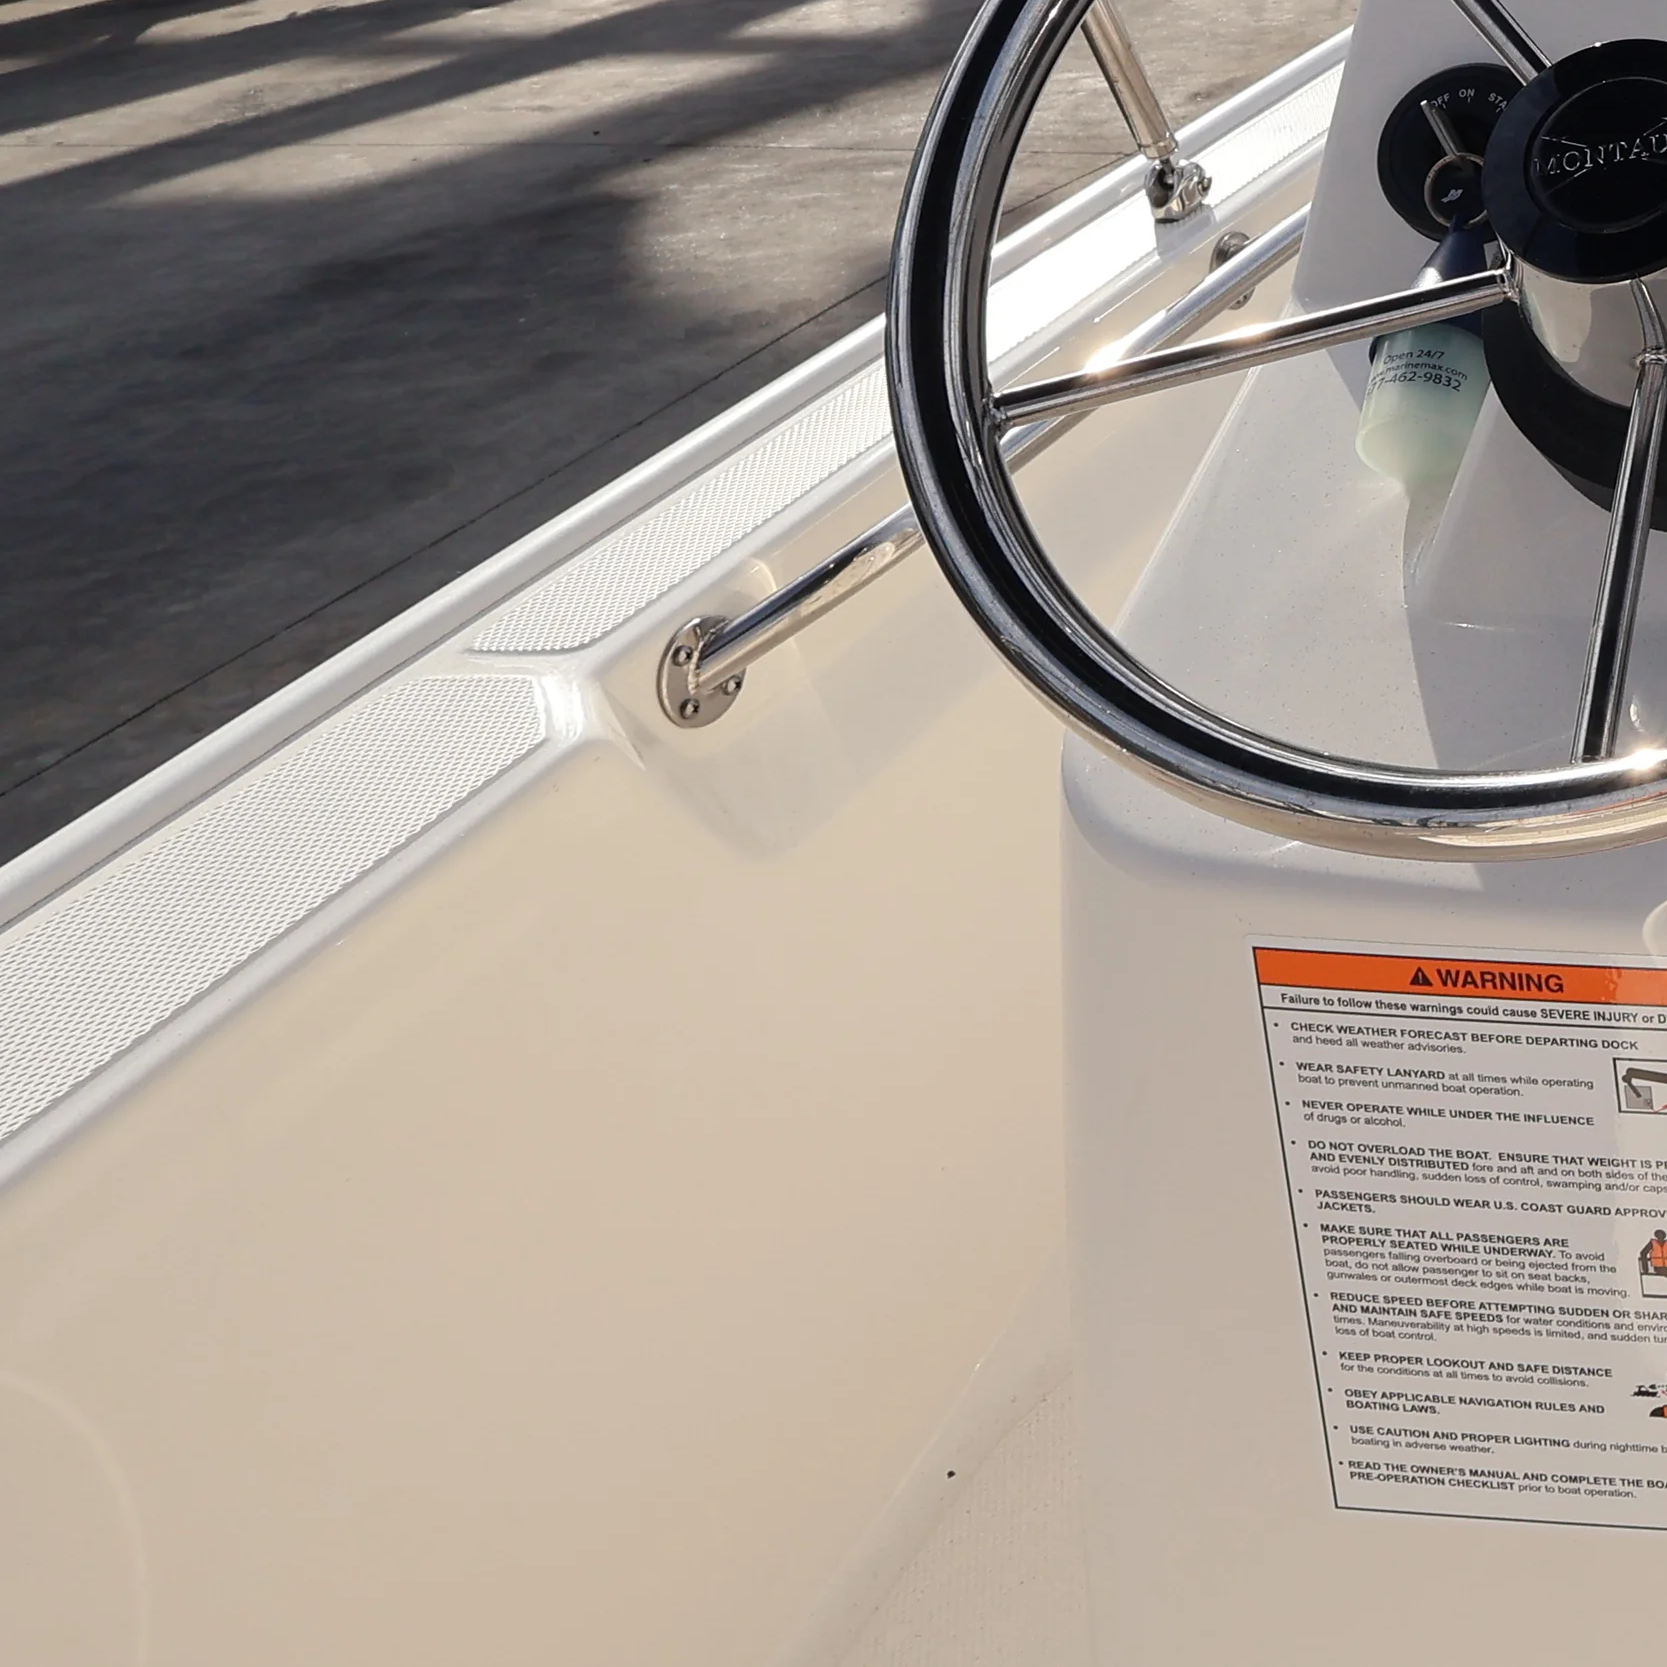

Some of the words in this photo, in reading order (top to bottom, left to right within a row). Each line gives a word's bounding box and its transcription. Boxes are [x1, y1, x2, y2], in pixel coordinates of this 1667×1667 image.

[1458, 88, 1475, 98] ON
[1383, 351, 1413, 365] Open
[1416, 349, 1445, 360] 24/7
[1435, 968, 1563, 993] WARNING
[1280, 992, 1319, 1005] Failure
[1322, 996, 1334, 1006] to
[1336, 996, 1372, 1008] follow
[1374, 999, 1406, 1010] these
[1409, 1002, 1463, 1016] warnings
[1466, 1005, 1499, 1015] could
[1502, 1008, 1537, 1018] cause
[1540, 1008, 1590, 1020] SEVERE
[1593, 1010, 1637, 1022] INJURY
[1641, 1015, 1654, 1023] or
[1290, 1021, 1333, 1033] CHECK
[1336, 1025, 1397, 1037] WEATHER
[1399, 1028, 1467, 1041] FORECAST
[1470, 1032, 1522, 1044] BEFORE
[1525, 1035, 1598, 1048] DEPARTING
[1601, 1039, 1638, 1049] DOCK
